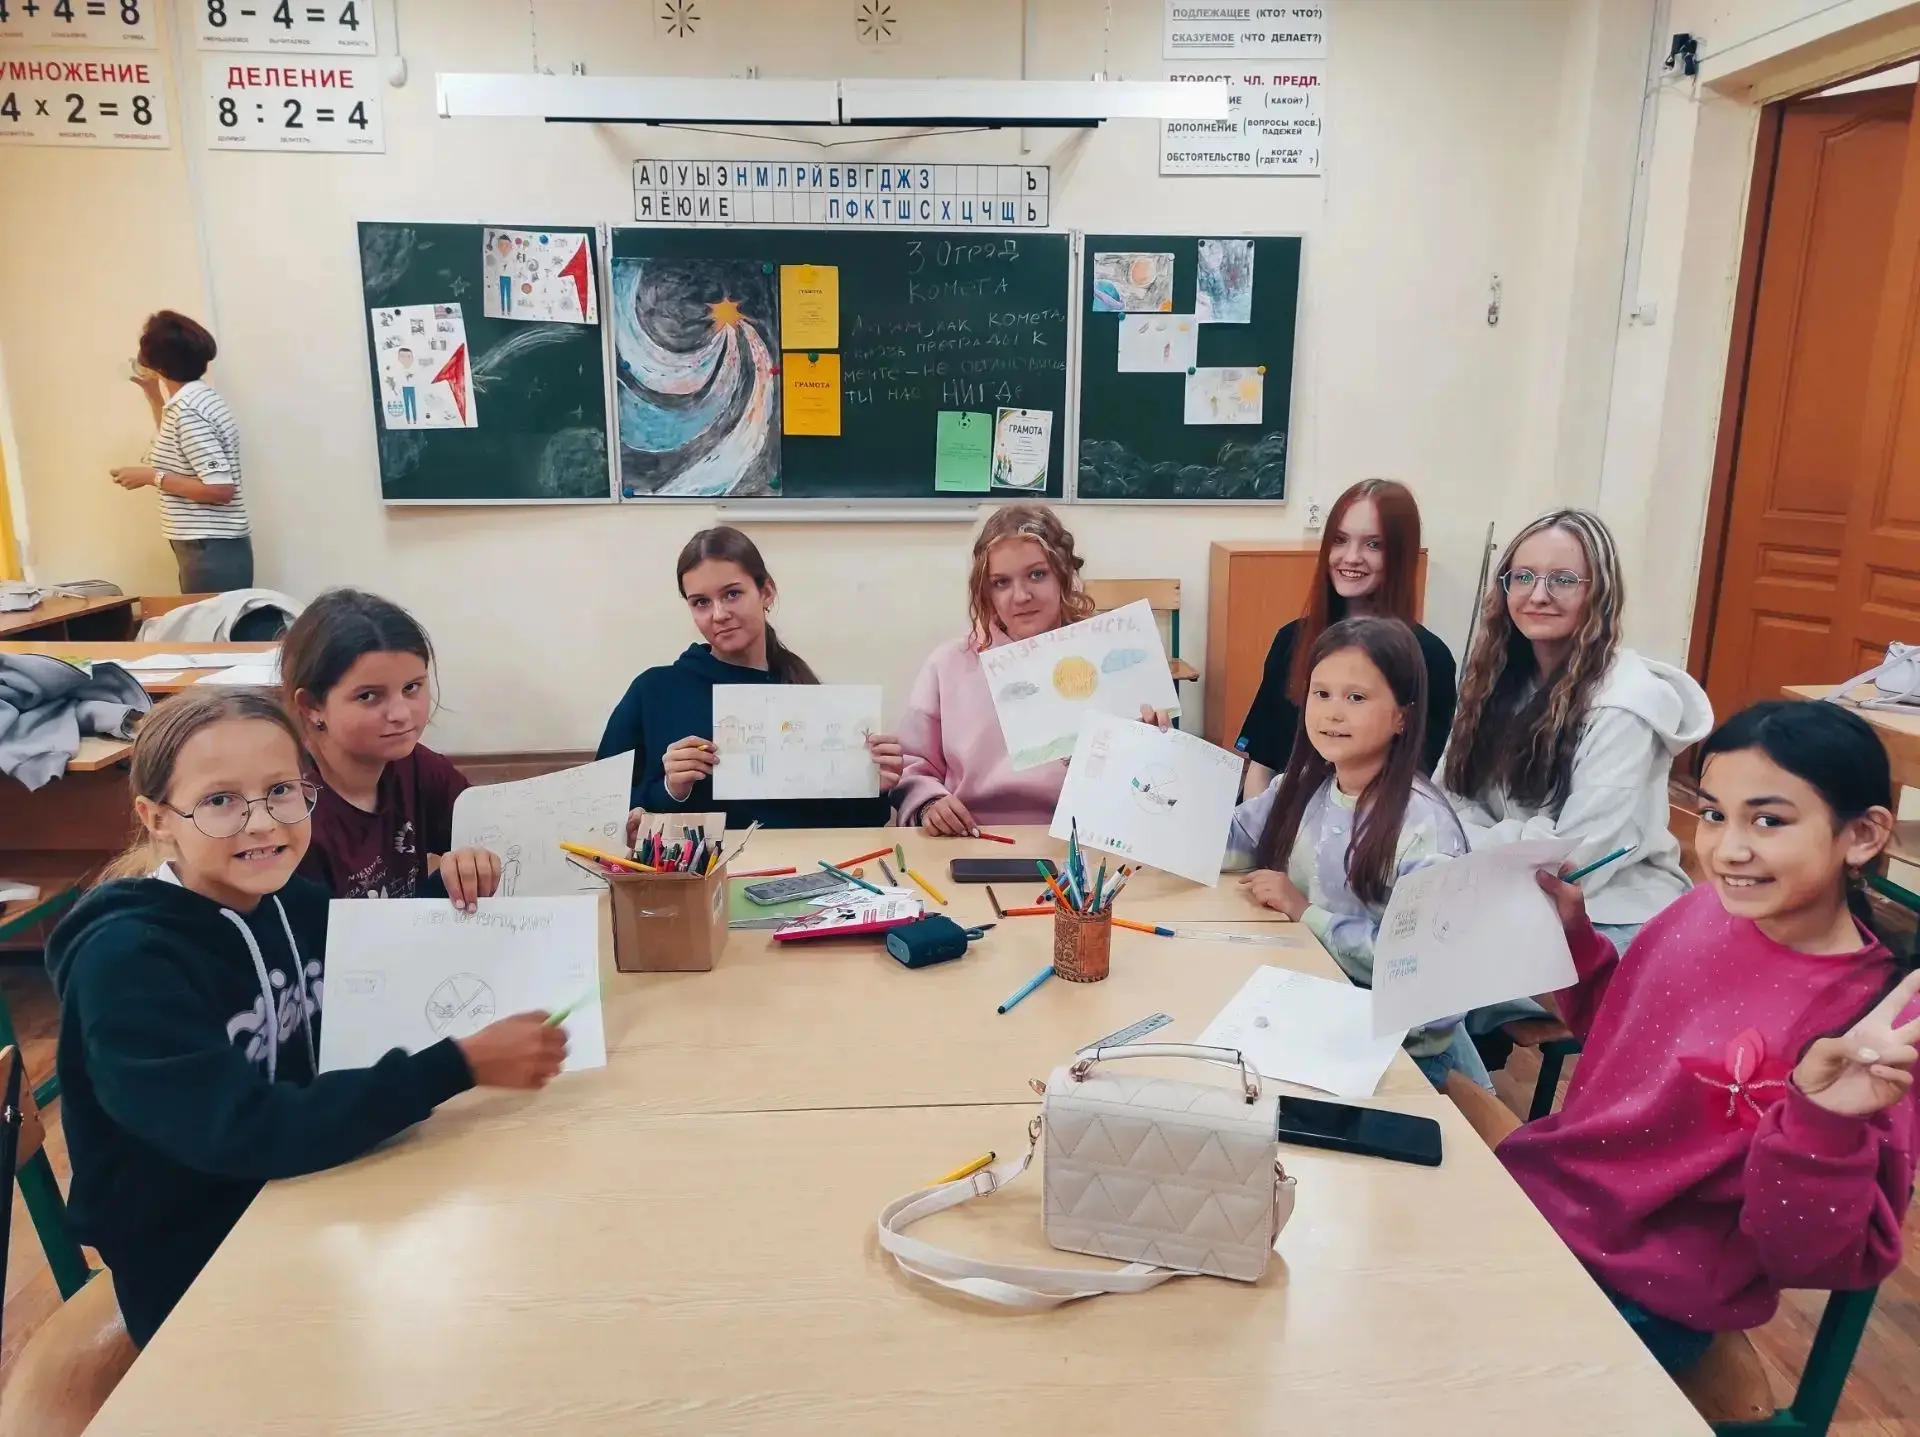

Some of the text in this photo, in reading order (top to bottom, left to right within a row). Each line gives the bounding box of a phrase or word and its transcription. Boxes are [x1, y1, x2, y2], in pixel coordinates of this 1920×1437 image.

[54, 0, 74, 23] 4
[120, 0, 140, 25] 8
[207, 0, 227, 28] 8
[273, 0, 294, 29] 4
[339, 0, 360, 31] 4
[1172, 9, 1323, 19] ПОДЛЕЖАЩЕЕ (КТО? ЧТО?)
[1171, 34, 1322, 43] СКАЗУЕМОЕ (ЧТО ДЕЛАЕТ?)
[227, 66, 354, 90] ДЕЛЕНИЕ
[1243, 76, 1265, 86] ЧЛ.
[1273, 76, 1321, 87] ПРЕДЛ.
[0, 92, 21, 122] 4
[65, 93, 87, 123] 2
[132, 95, 152, 126] 8
[218, 97, 238, 127] 8
[283, 99, 303, 128] 2
[348, 101, 368, 130] 4
[1167, 123, 1238, 133] ДОПОЛНЕНИЕ
[1166, 152, 1250, 162] ОБСТОЯТЕЛЬСТВО
[907, 240, 926, 275] 3
[794, 381, 831, 389] ГРАМОТА
[1008, 423, 1043, 436] ГРАМОТА
